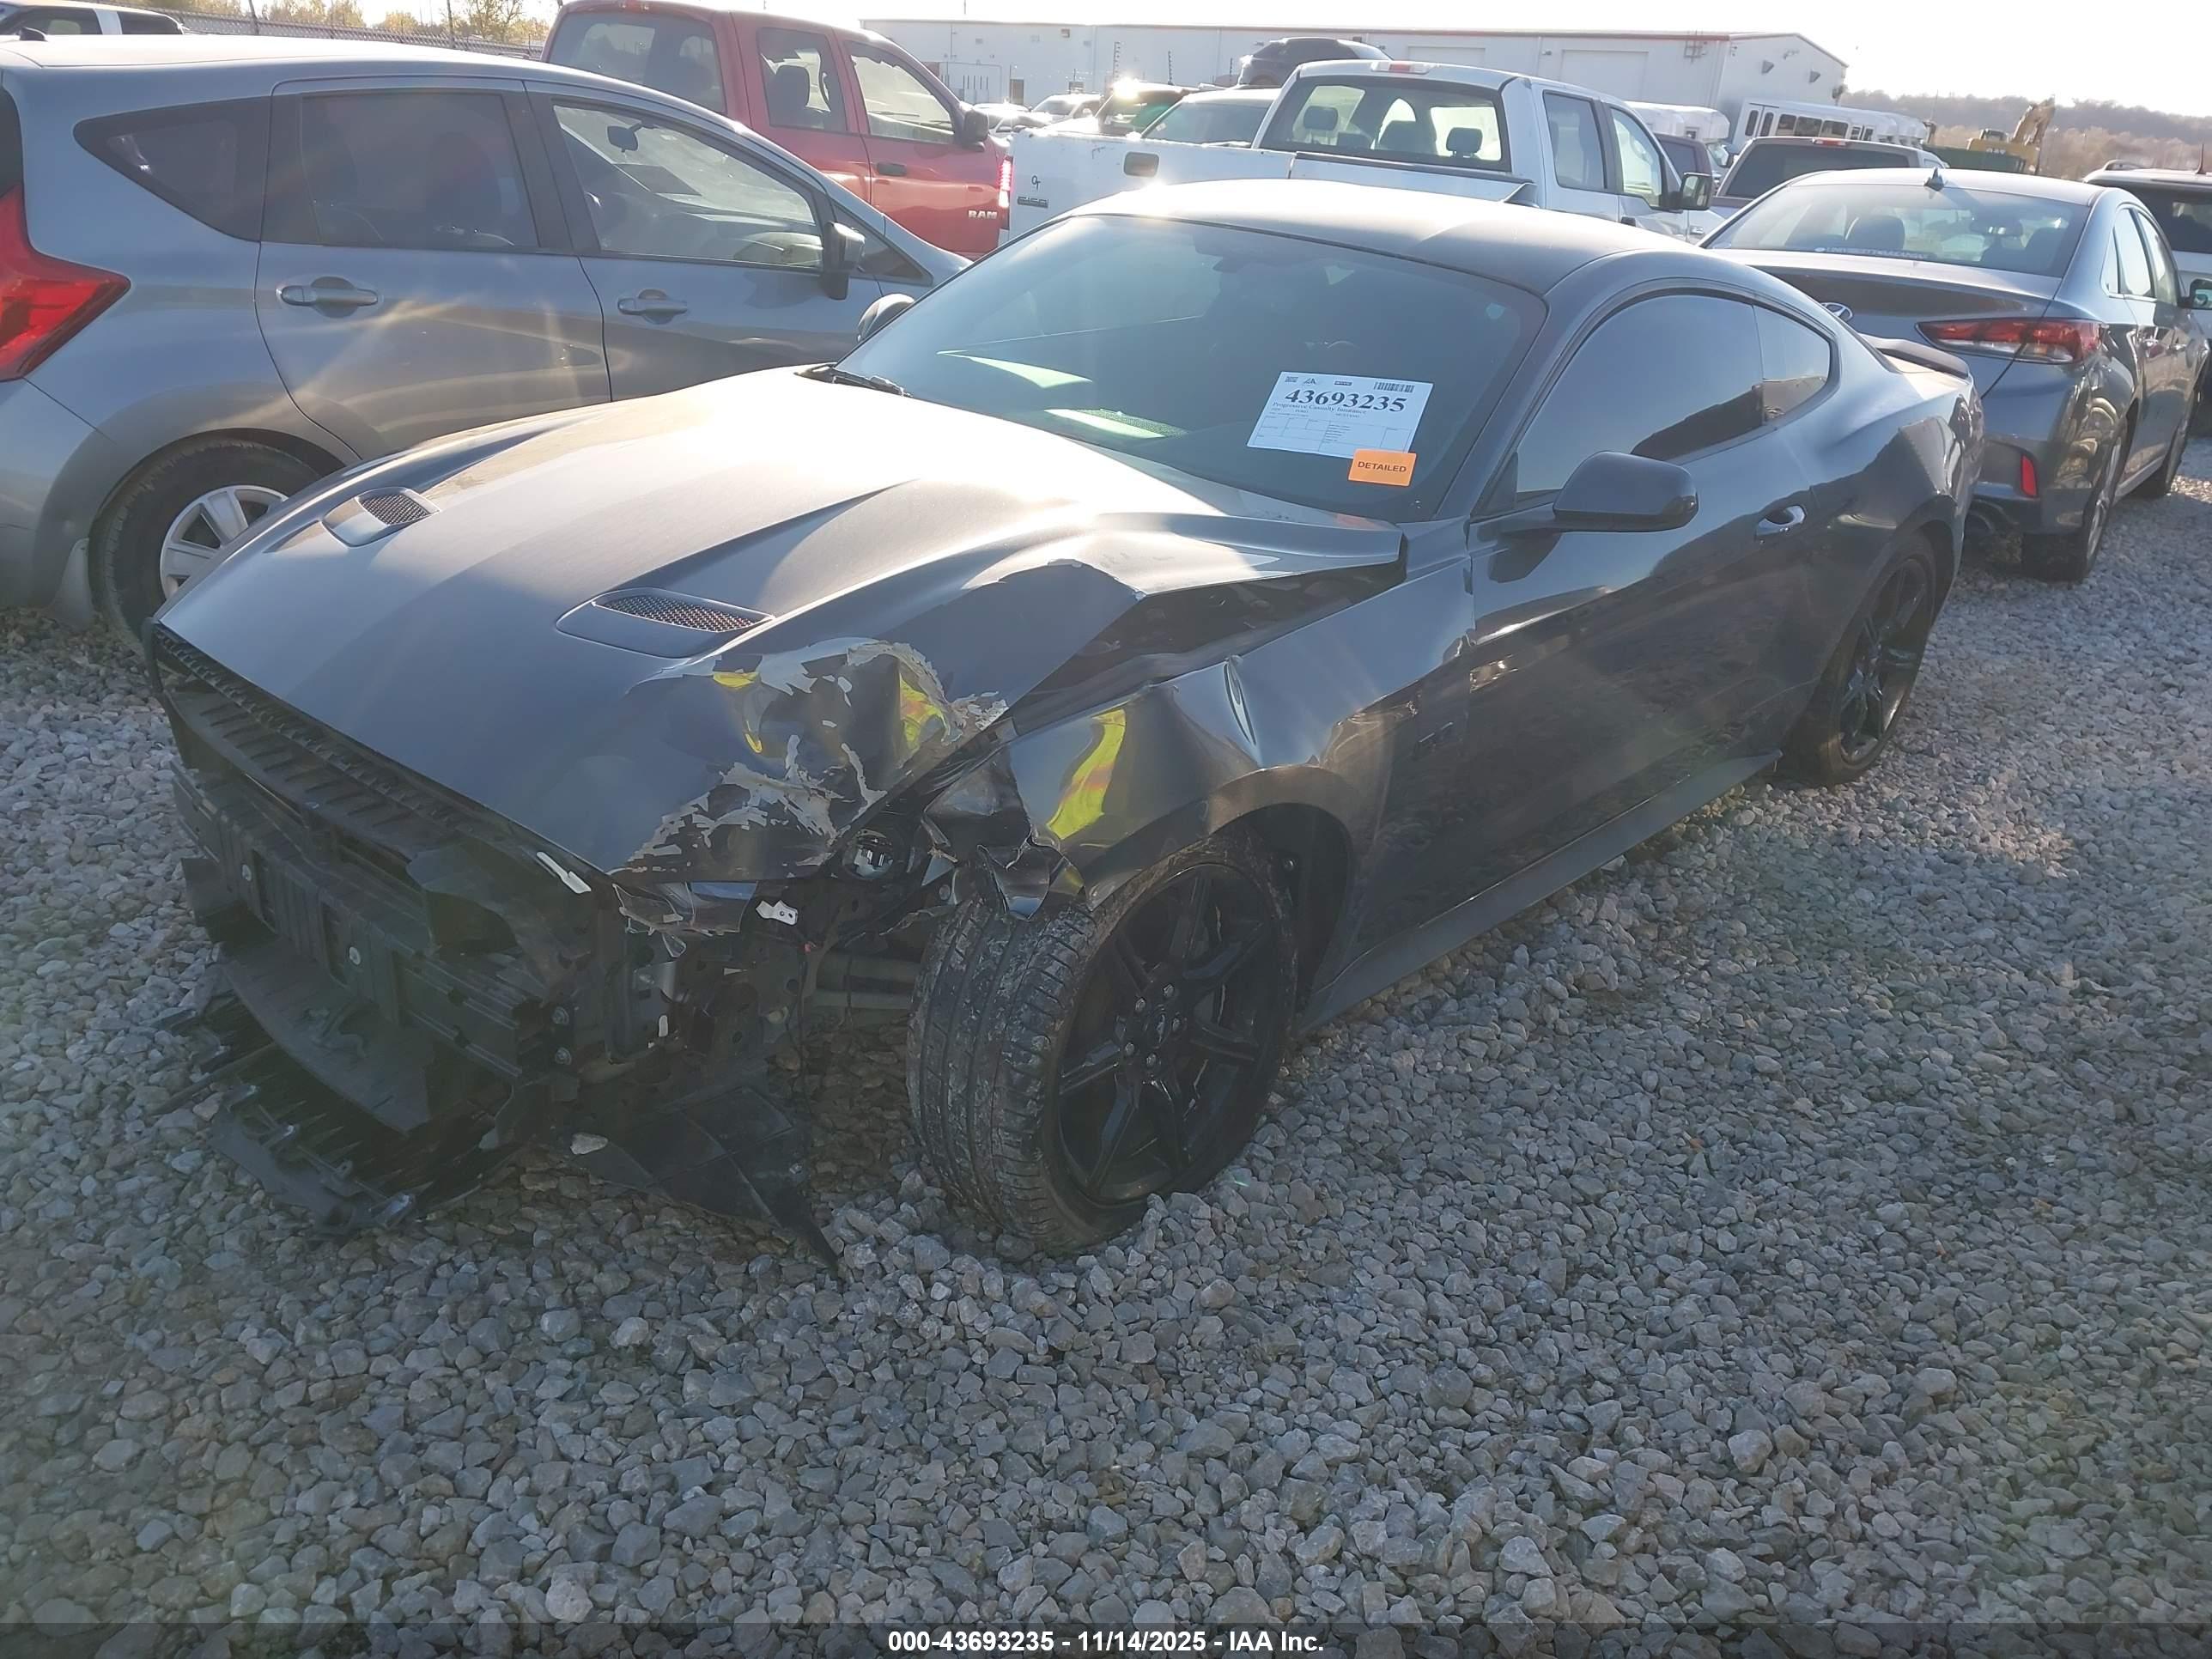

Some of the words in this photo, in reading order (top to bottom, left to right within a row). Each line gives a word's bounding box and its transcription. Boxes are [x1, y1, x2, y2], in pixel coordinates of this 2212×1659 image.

[968, 210, 998, 220] RAM
[1285, 389, 1408, 412] 43693235
[1357, 460, 1407, 473] DETAILED
